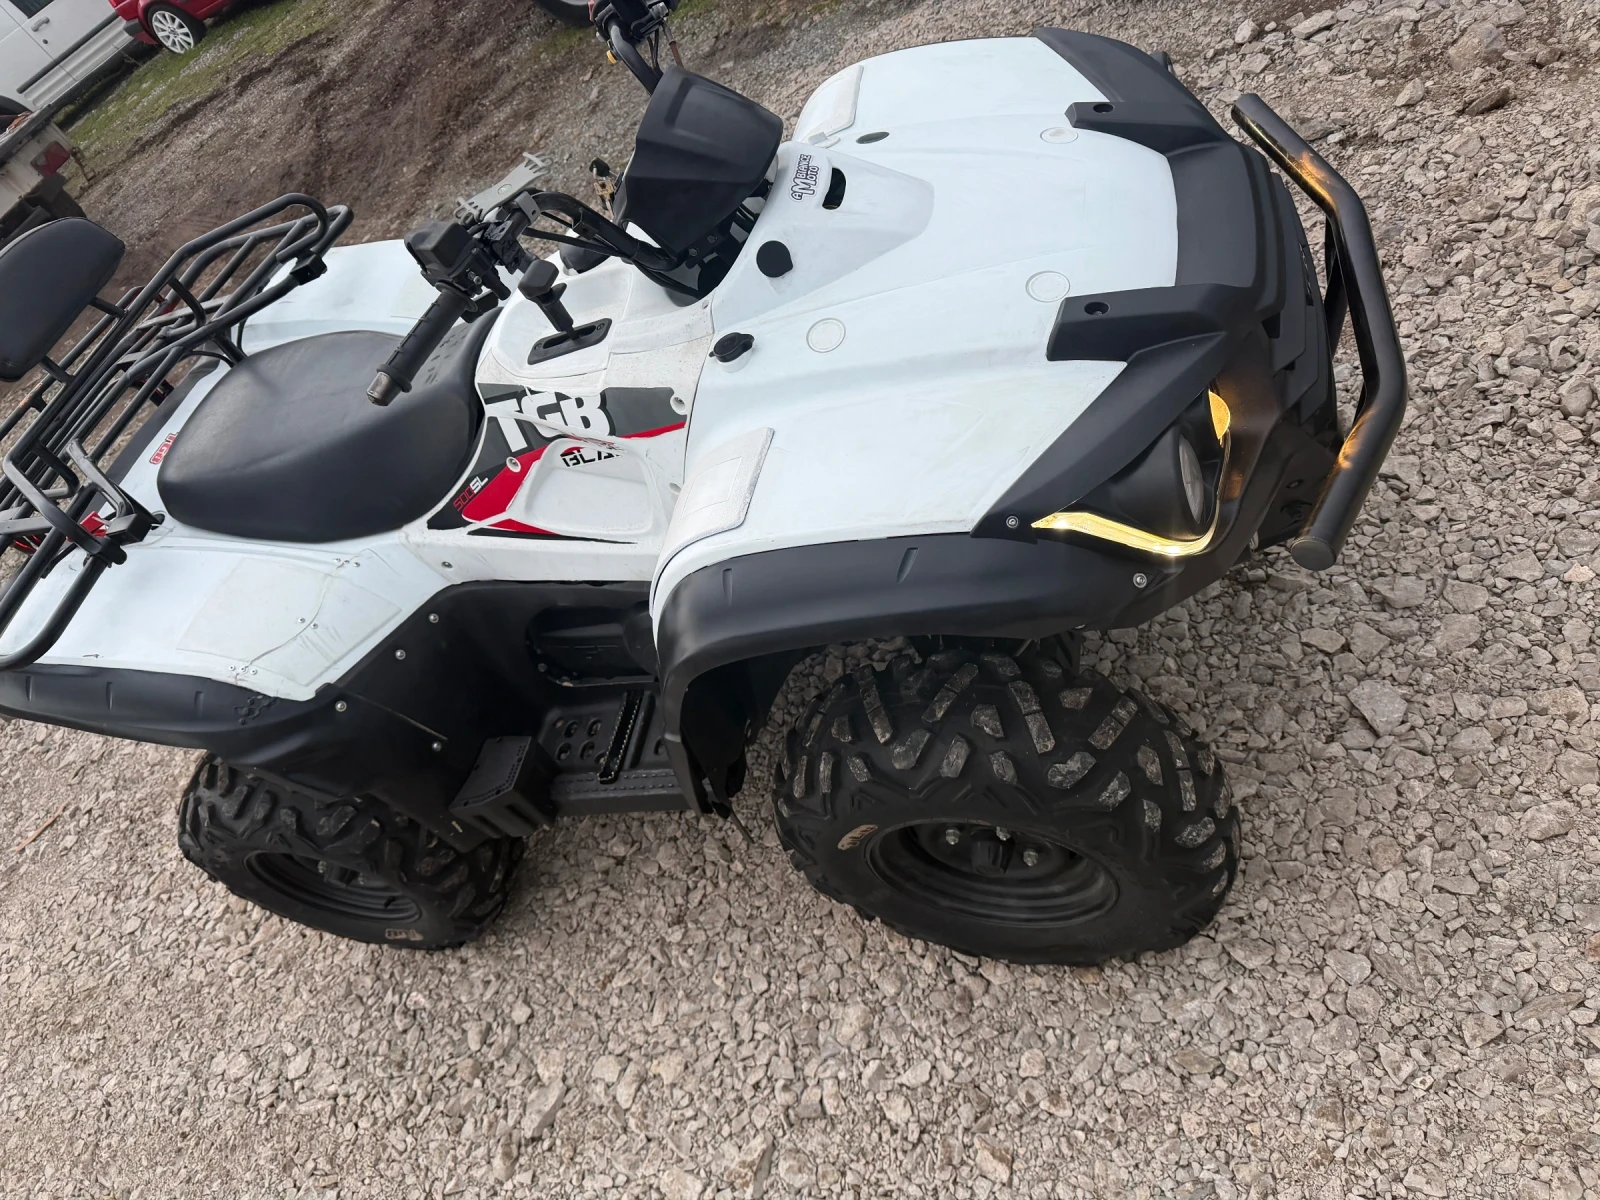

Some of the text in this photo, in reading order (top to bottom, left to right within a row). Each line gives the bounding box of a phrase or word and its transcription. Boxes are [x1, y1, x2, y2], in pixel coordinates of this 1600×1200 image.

[485, 389, 611, 453] TGB
[560, 446, 622, 468] BLA
[453, 477, 489, 511] 500SL
